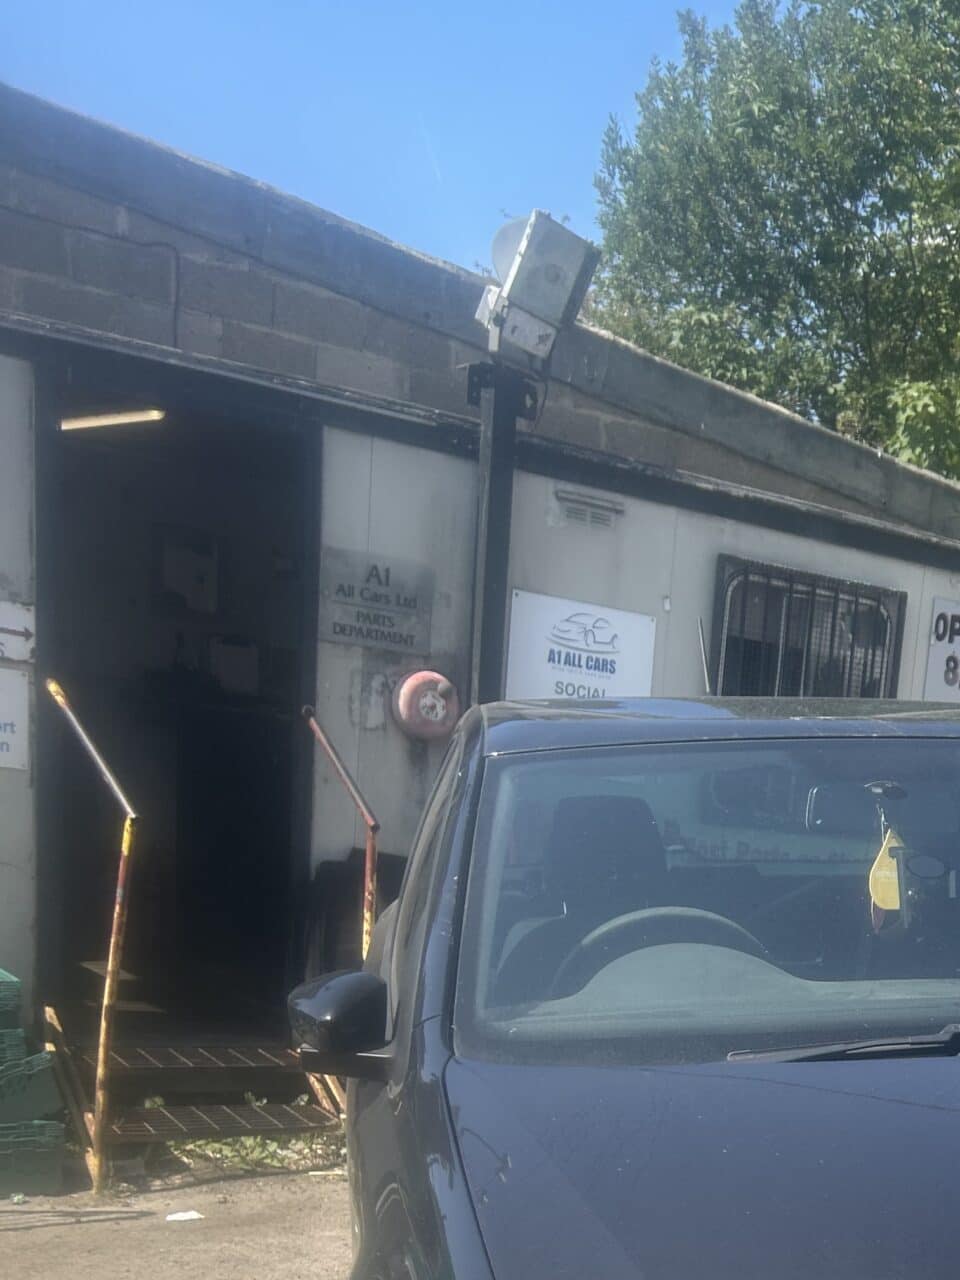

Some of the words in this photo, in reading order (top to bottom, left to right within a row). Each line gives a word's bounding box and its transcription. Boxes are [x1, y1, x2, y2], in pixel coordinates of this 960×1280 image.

[366, 564, 391, 587] A1
[335, 583, 355, 599] All
[359, 587, 391, 605] Cars
[395, 593, 418, 609] Ltd
[355, 610, 395, 629] PARTS
[332, 621, 417, 647] DEPARTMENT
[547, 648, 562, 665] A1
[563, 651, 583, 668] ALL
[585, 655, 616, 674] CARS
